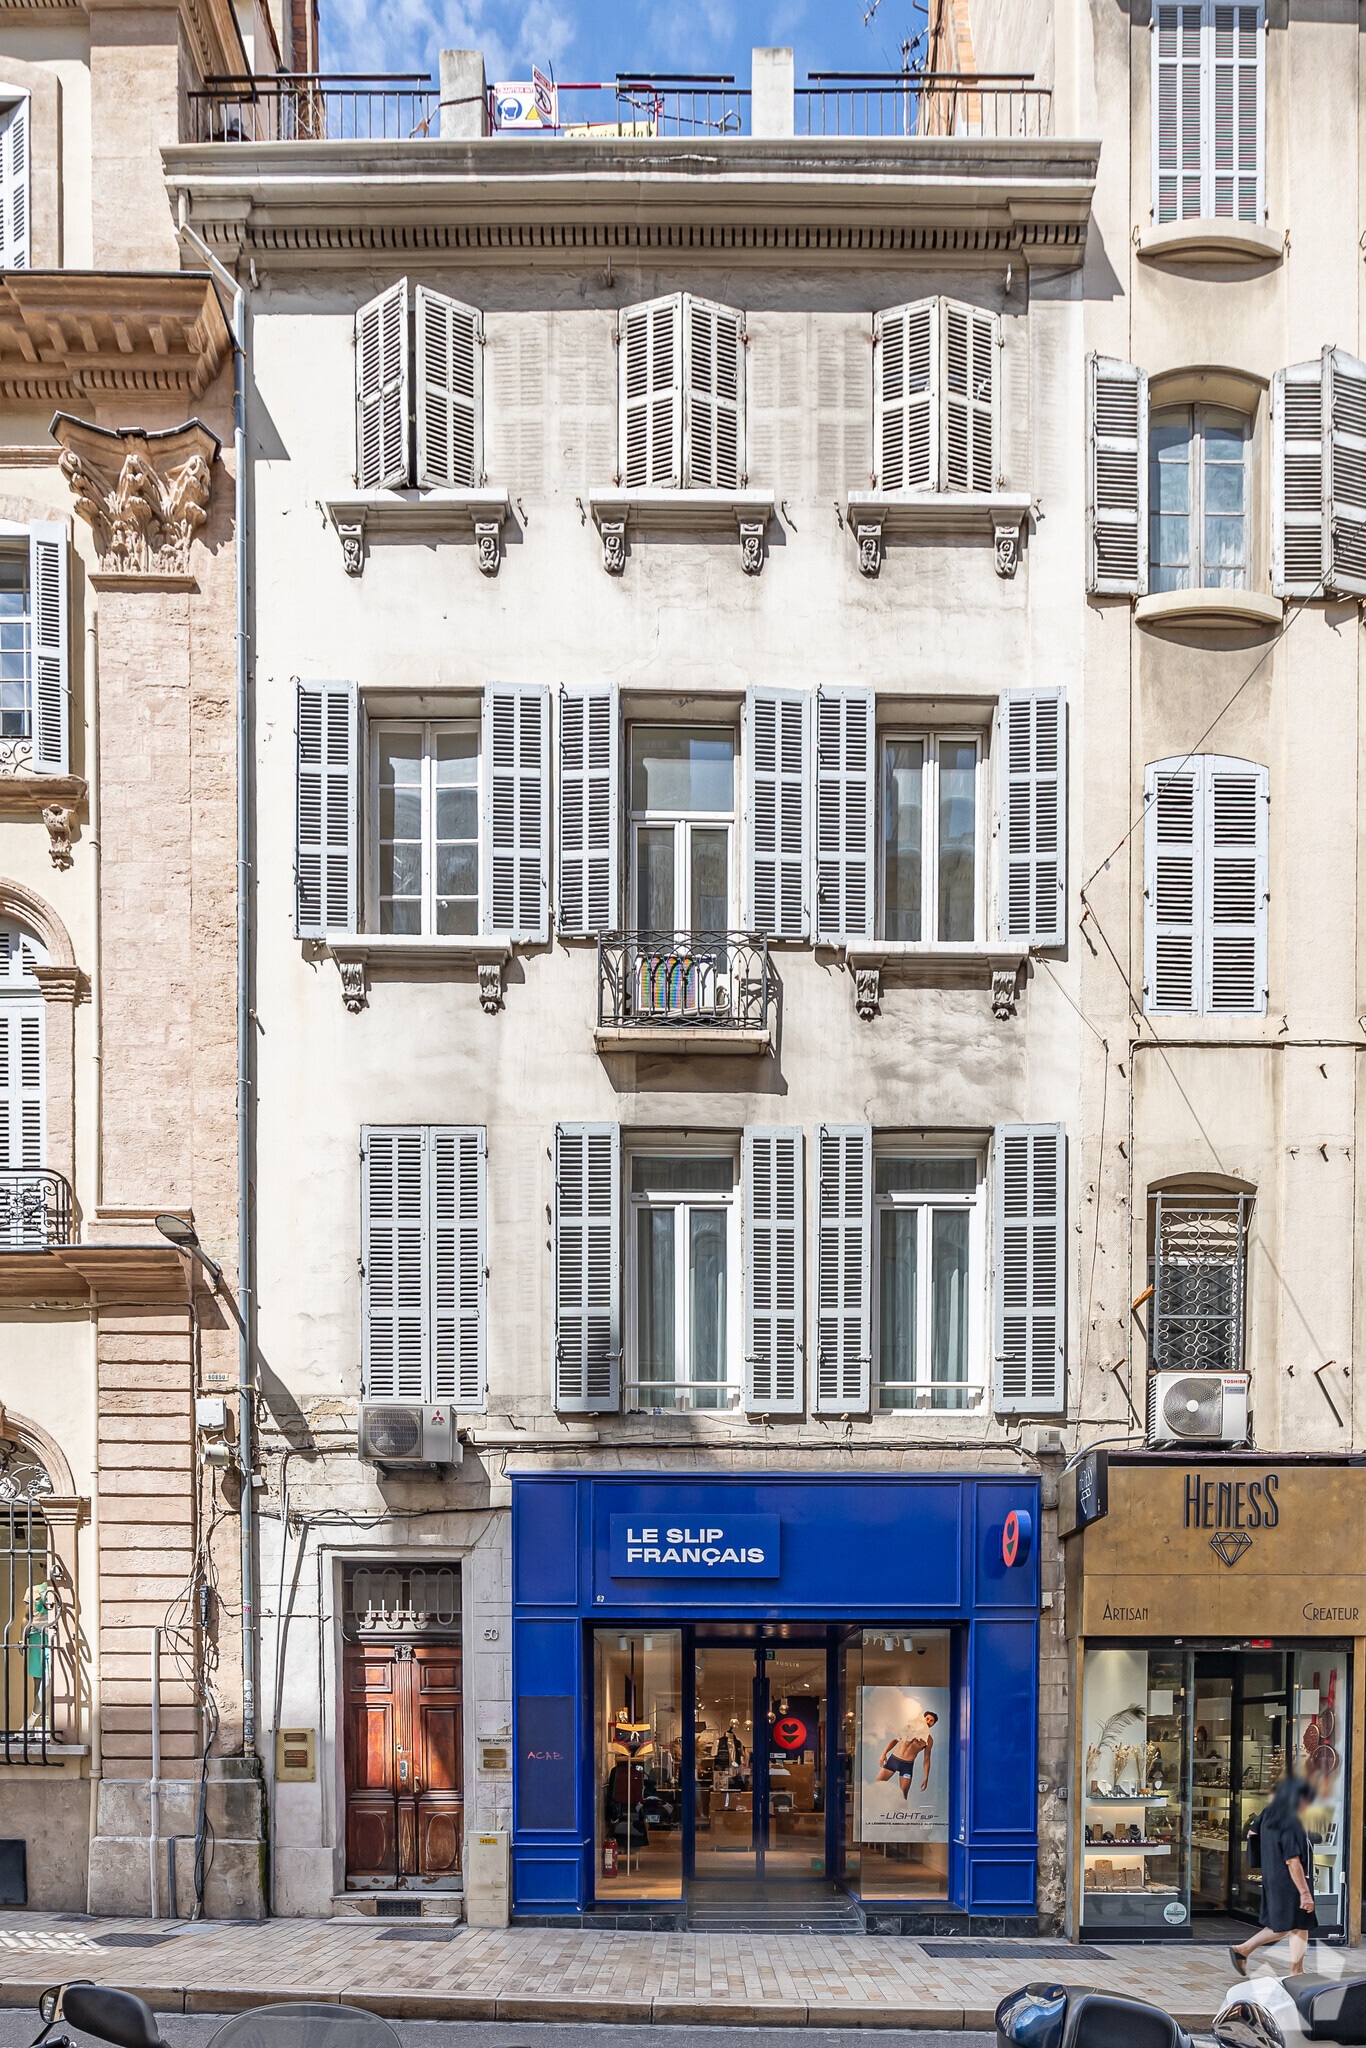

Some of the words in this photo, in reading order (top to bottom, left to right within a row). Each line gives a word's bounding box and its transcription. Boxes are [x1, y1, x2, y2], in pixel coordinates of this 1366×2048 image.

[1184, 1474, 1279, 1529] HENESS
[626, 1528, 659, 1543] LE
[666, 1528, 724, 1544] SLIP
[626, 1547, 765, 1566] FRANÇAIS
[484, 1629, 499, 1641] 50
[527, 1751, 564, 1760] ACAB
